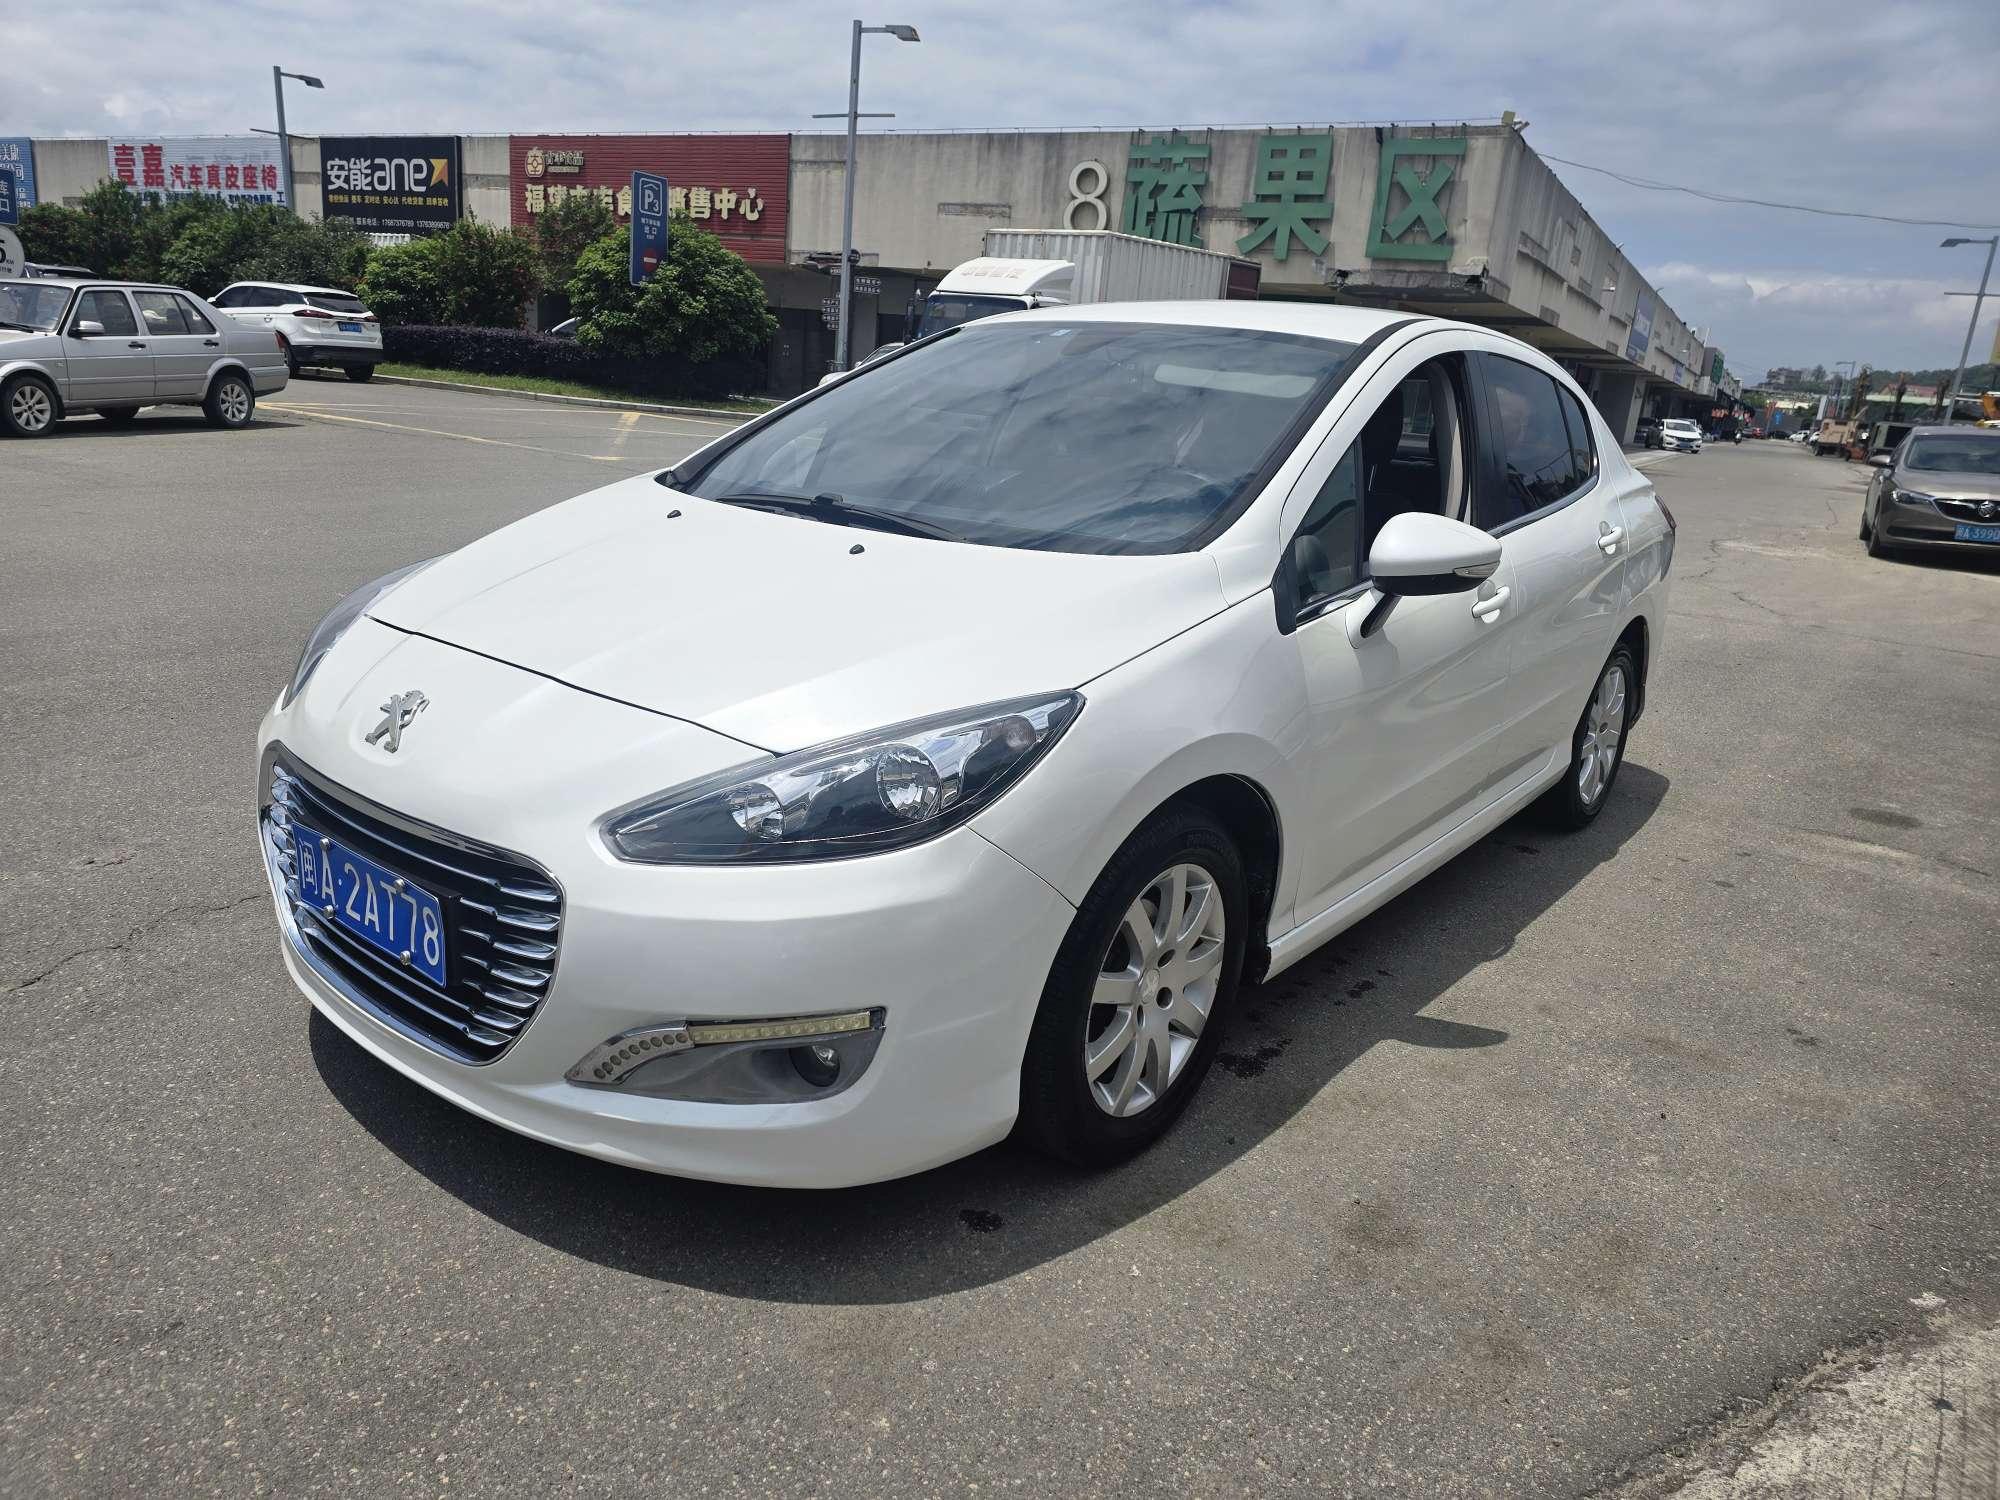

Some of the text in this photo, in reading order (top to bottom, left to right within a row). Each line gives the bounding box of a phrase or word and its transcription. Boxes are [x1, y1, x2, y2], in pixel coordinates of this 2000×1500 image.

[170, 163, 277, 191] 汽车真皮座椅
[1063, 134, 1468, 261] 8 蔬果区
